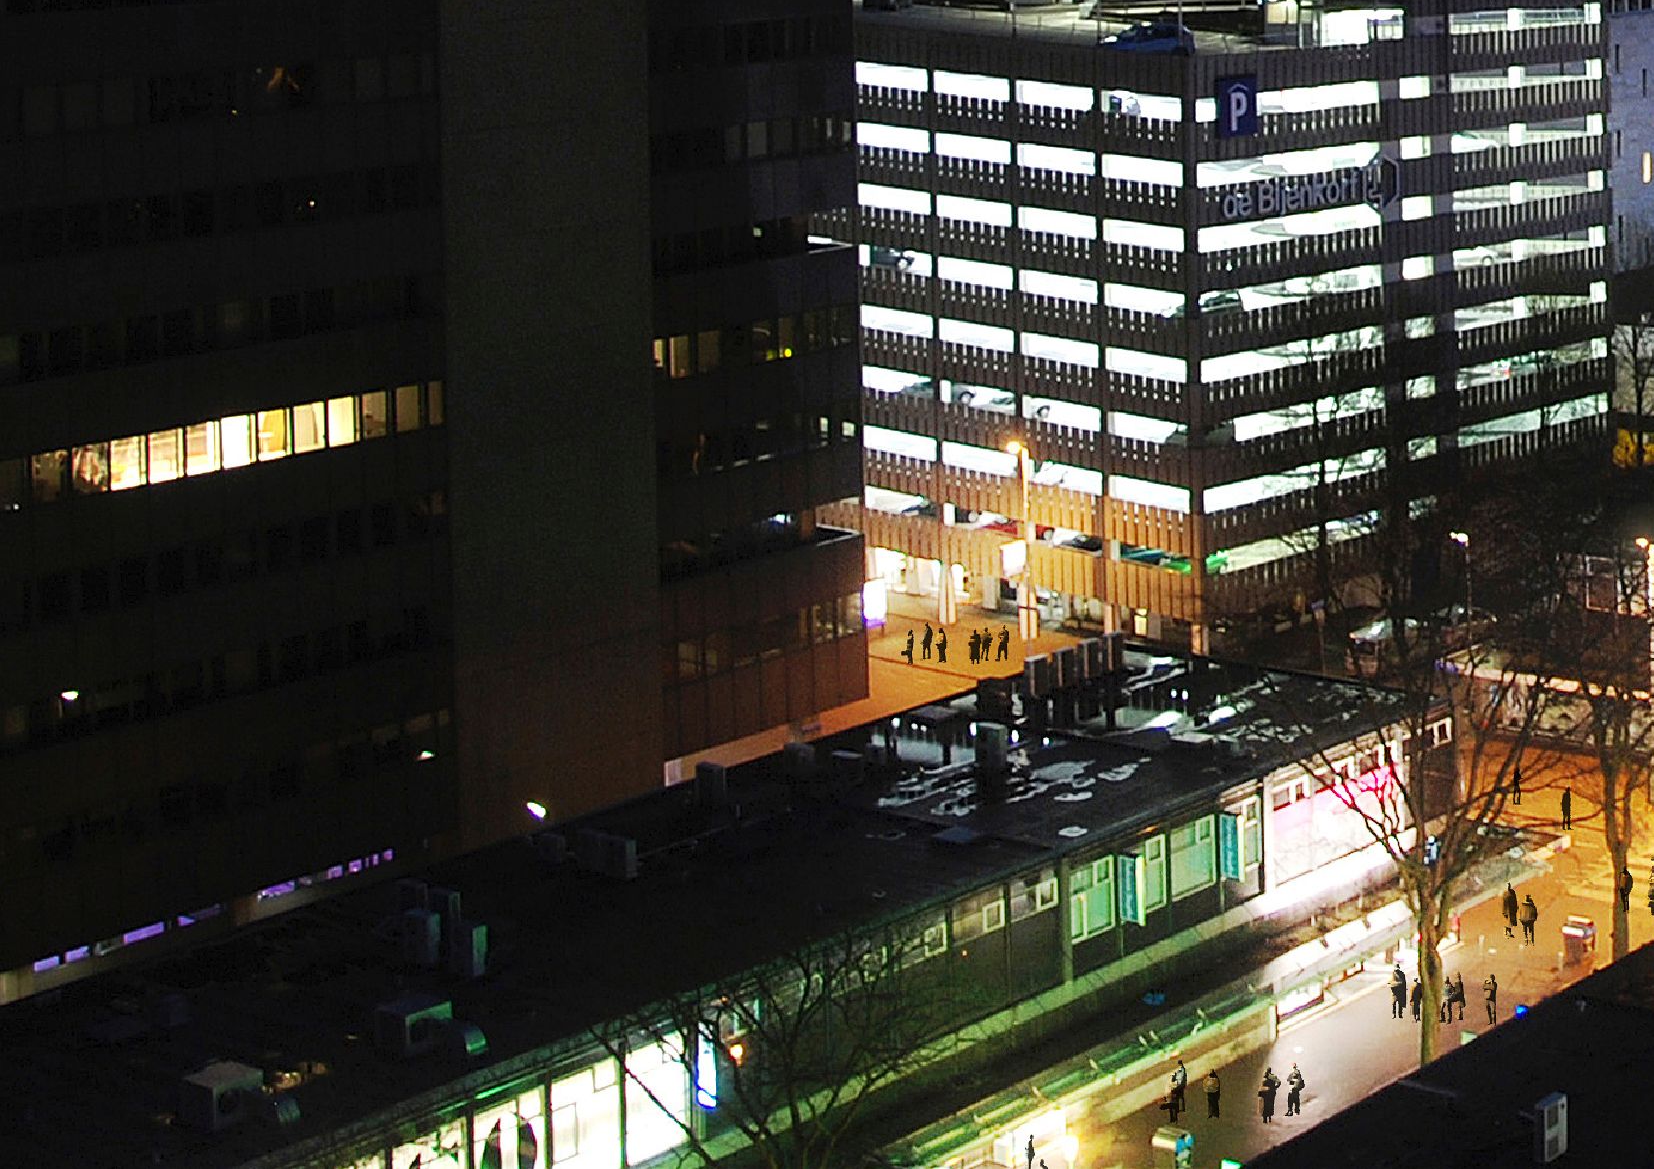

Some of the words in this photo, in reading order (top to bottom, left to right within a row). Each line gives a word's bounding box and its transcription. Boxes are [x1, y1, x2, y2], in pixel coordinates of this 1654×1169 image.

[1230, 92, 1247, 131] P
[1224, 188, 1252, 218] de
[1257, 168, 1358, 216] Bijenkorf
